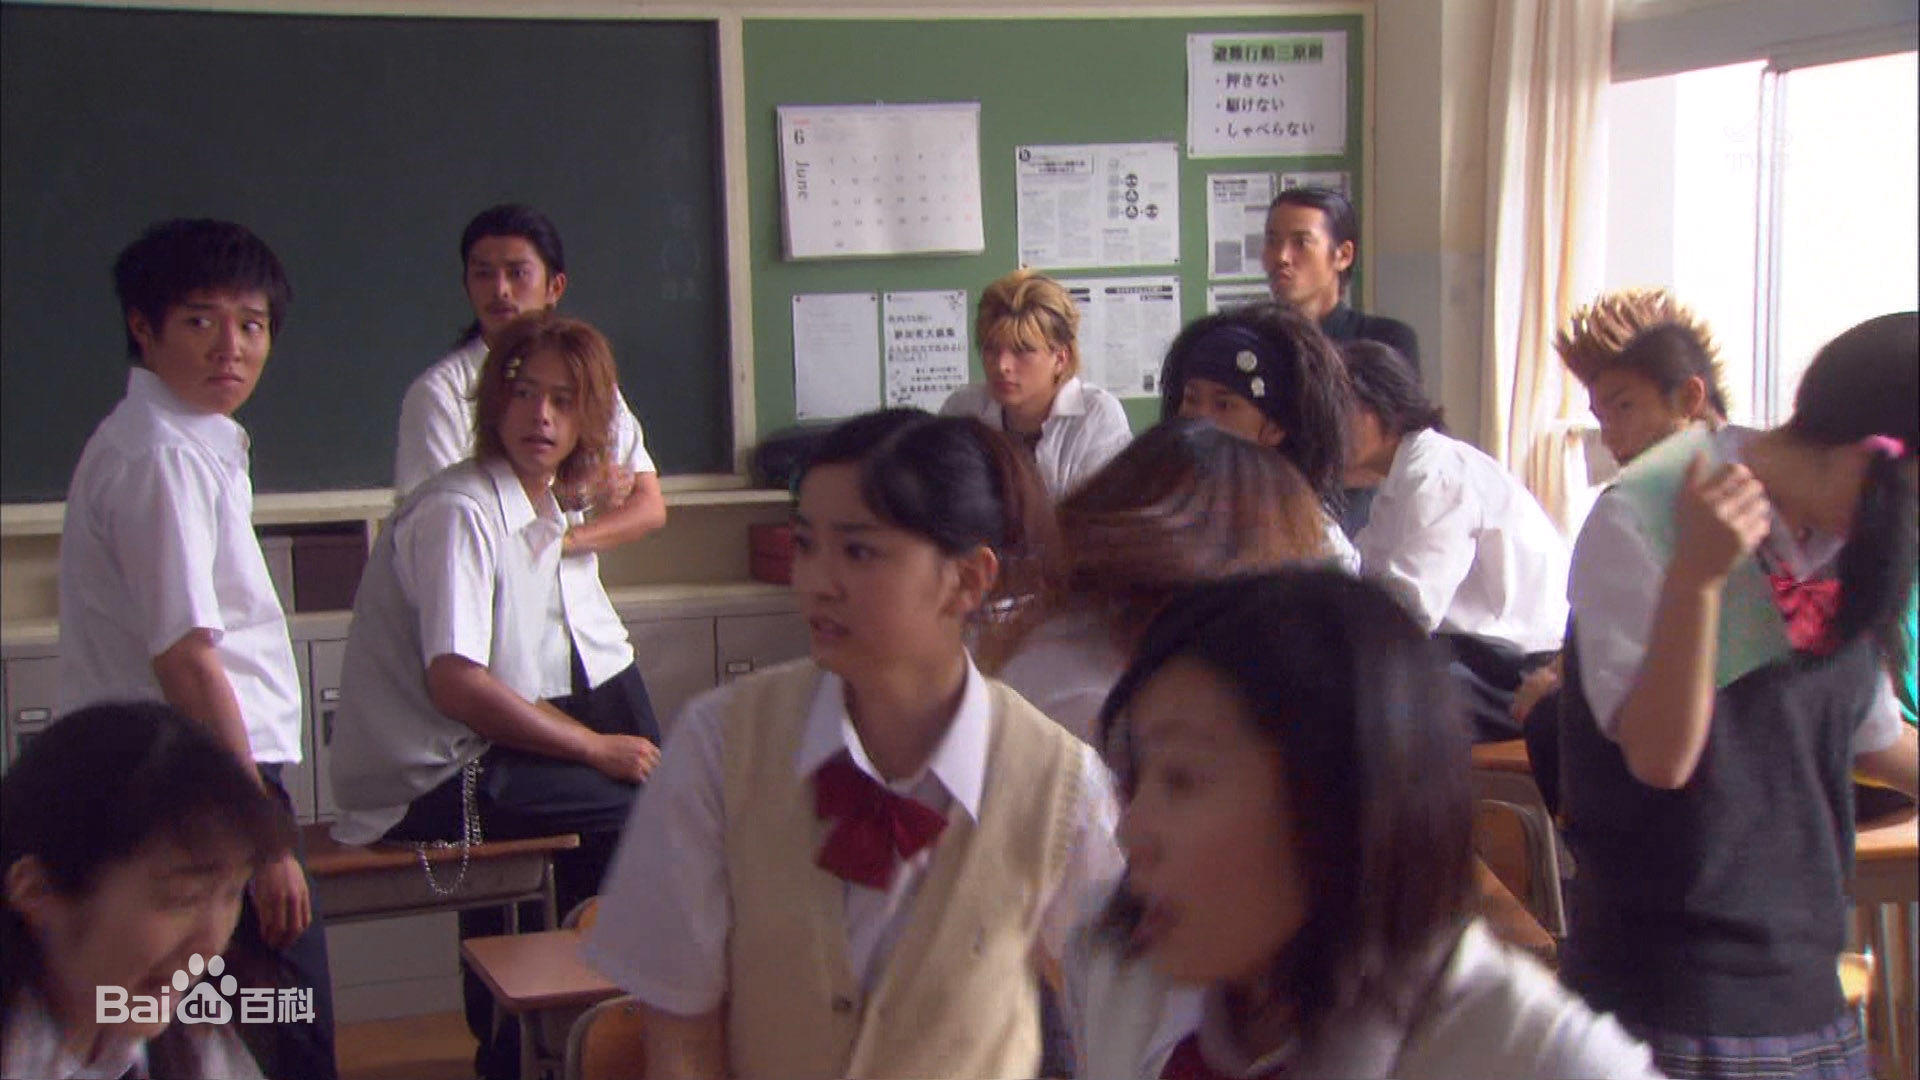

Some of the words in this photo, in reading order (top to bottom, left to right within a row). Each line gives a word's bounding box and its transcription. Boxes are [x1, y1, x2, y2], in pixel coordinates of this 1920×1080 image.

[794, 128, 805, 144] 6
[1227, 121, 1315, 138] しゃべらない
[795, 160, 810, 199] June
